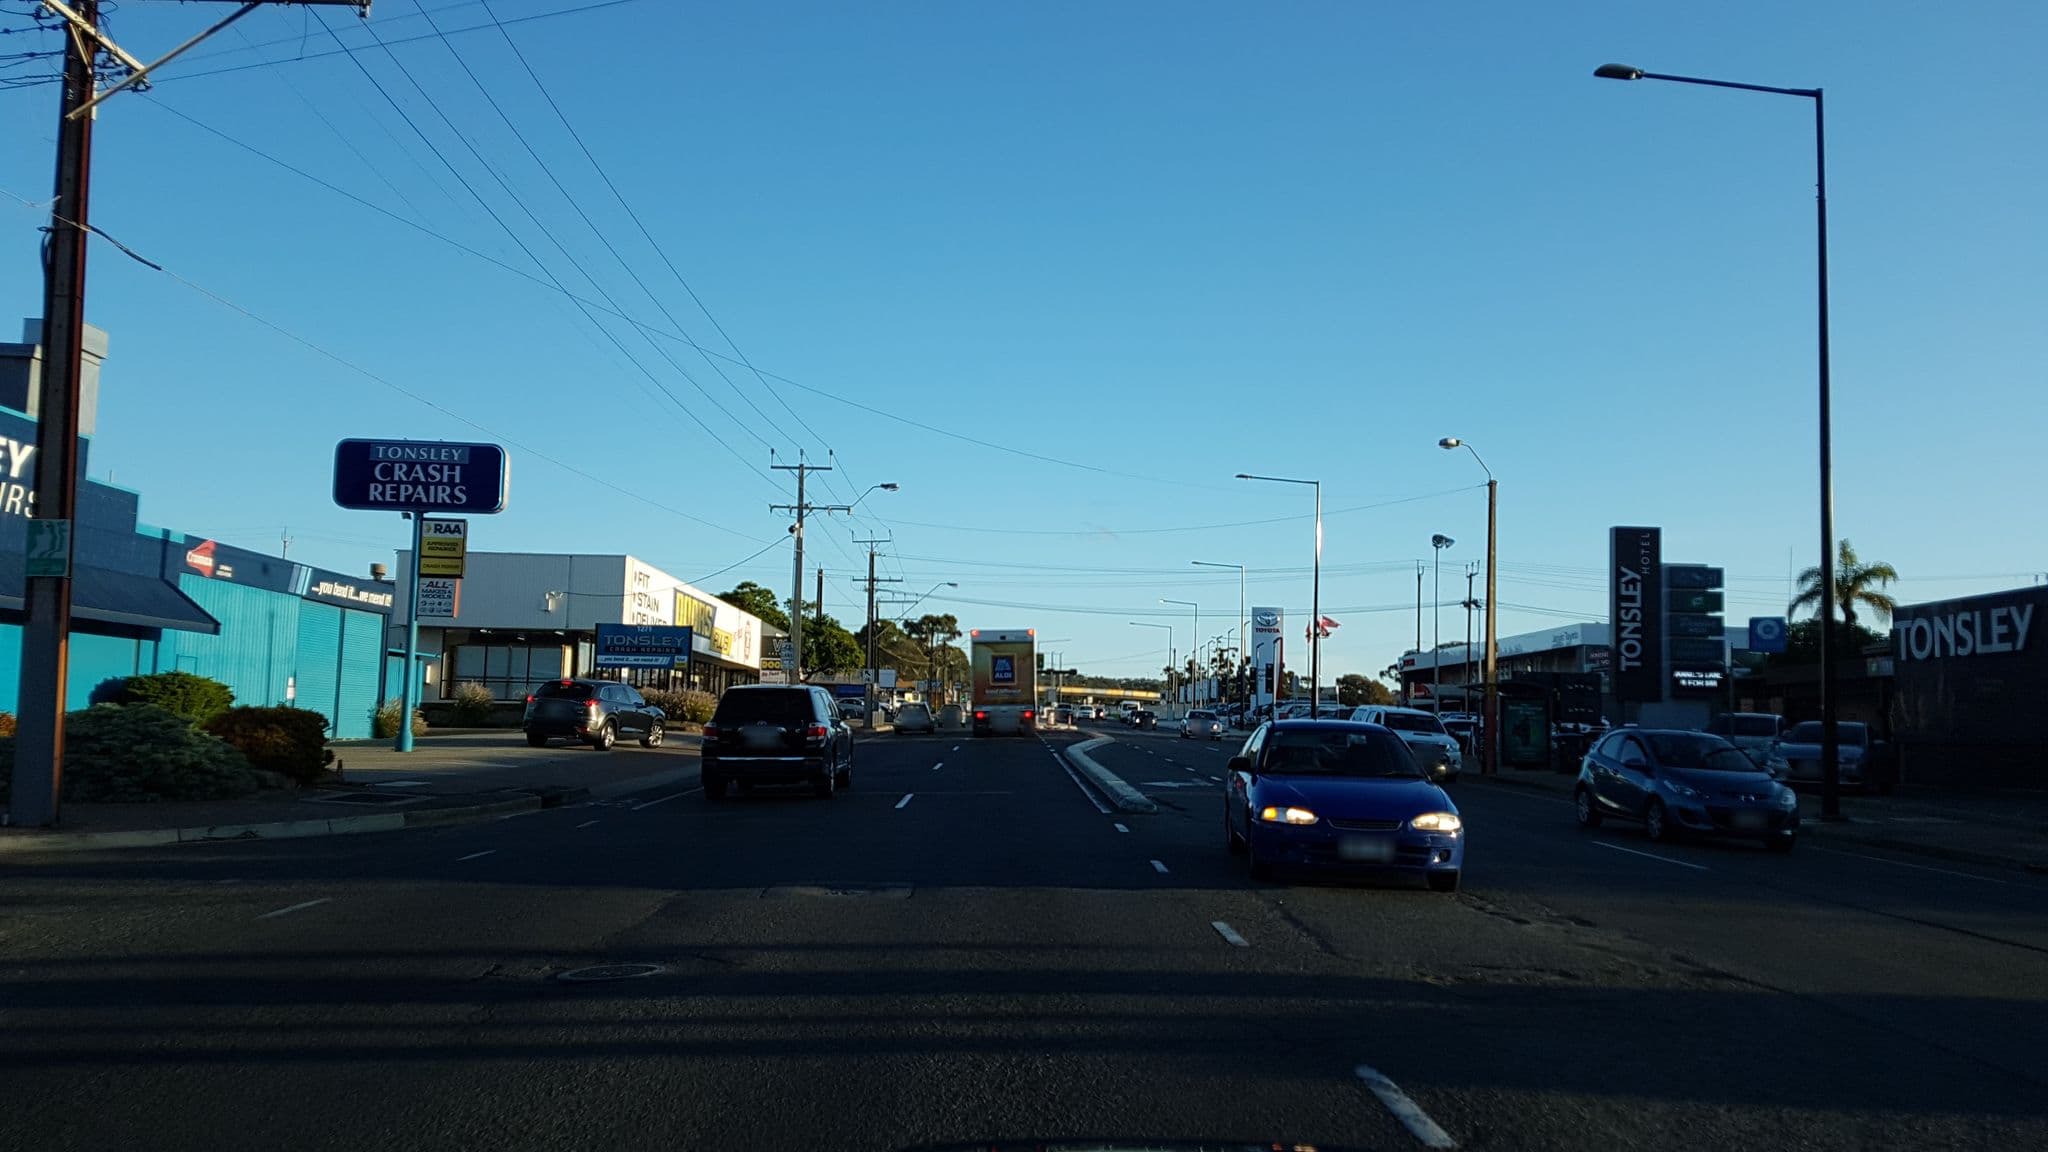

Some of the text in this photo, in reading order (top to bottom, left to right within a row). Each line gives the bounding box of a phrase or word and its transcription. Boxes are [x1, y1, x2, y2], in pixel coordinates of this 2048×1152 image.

[375, 446, 462, 461] TONSLEY
[373, 462, 461, 483] CRASH
[369, 483, 467, 505] REPAIRS
[433, 523, 462, 534] RAA
[1640, 532, 1651, 575] HOTEL
[426, 581, 449, 589] ALL
[637, 571, 651, 589] FIT
[637, 591, 660, 613] STAIN
[1619, 566, 1642, 672] TONSLEY
[603, 634, 686, 647] TONSLEY
[1894, 603, 2035, 662] TONSLEY
